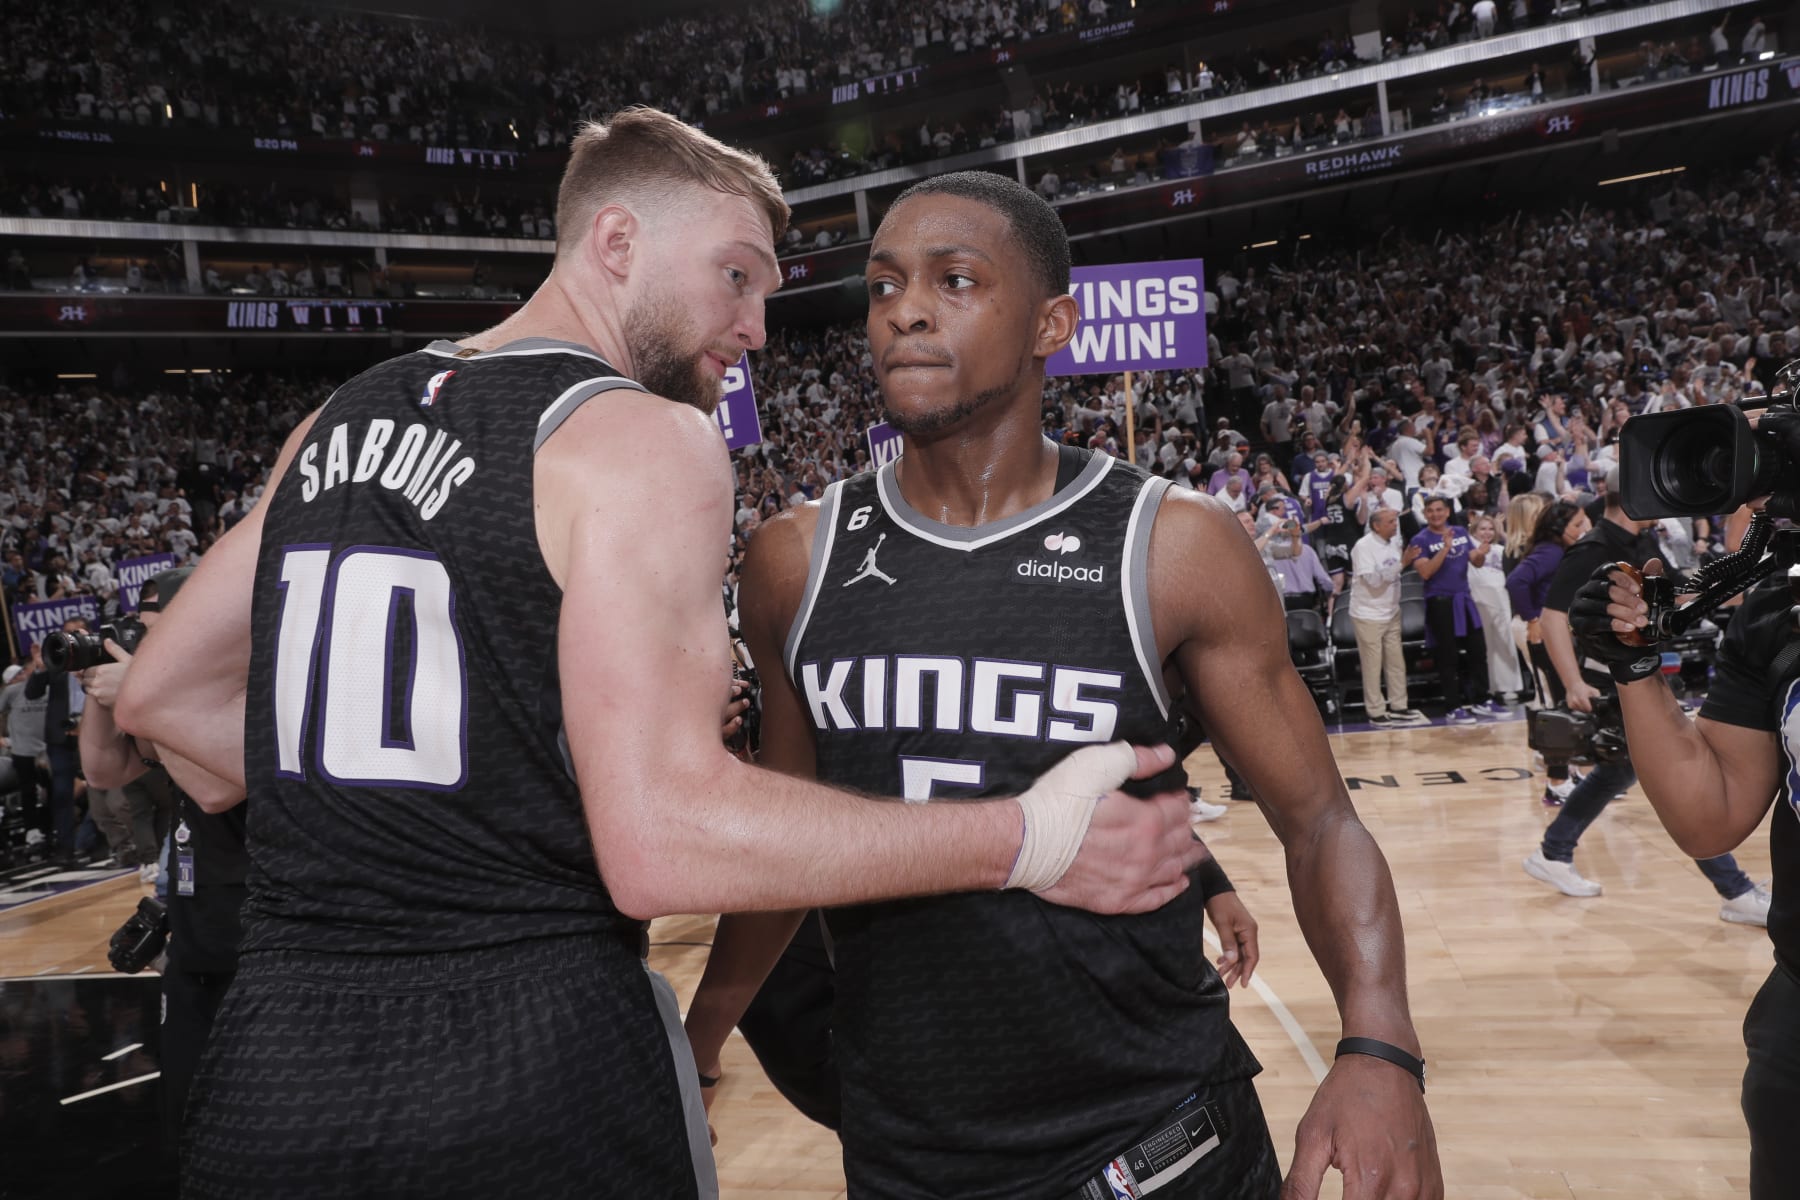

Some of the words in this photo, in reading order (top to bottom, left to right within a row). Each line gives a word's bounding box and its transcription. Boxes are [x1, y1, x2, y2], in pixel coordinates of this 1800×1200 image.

[1079, 20, 1135, 40] REDHAWK
[1708, 67, 1770, 110] KINGS
[1305, 145, 1401, 174] REDHAWK
[227, 302, 279, 328] KINGS
[1069, 320, 1176, 363] WIN!
[300, 418, 476, 521] SABONIS
[847, 506, 873, 531] 6
[1017, 559, 1104, 583] dialpad
[273, 543, 469, 792] 10
[801, 654, 1126, 743] KINGS
[1143, 1126, 1181, 1151] ENGINEERED
[1134, 1159, 1145, 1171] 46
